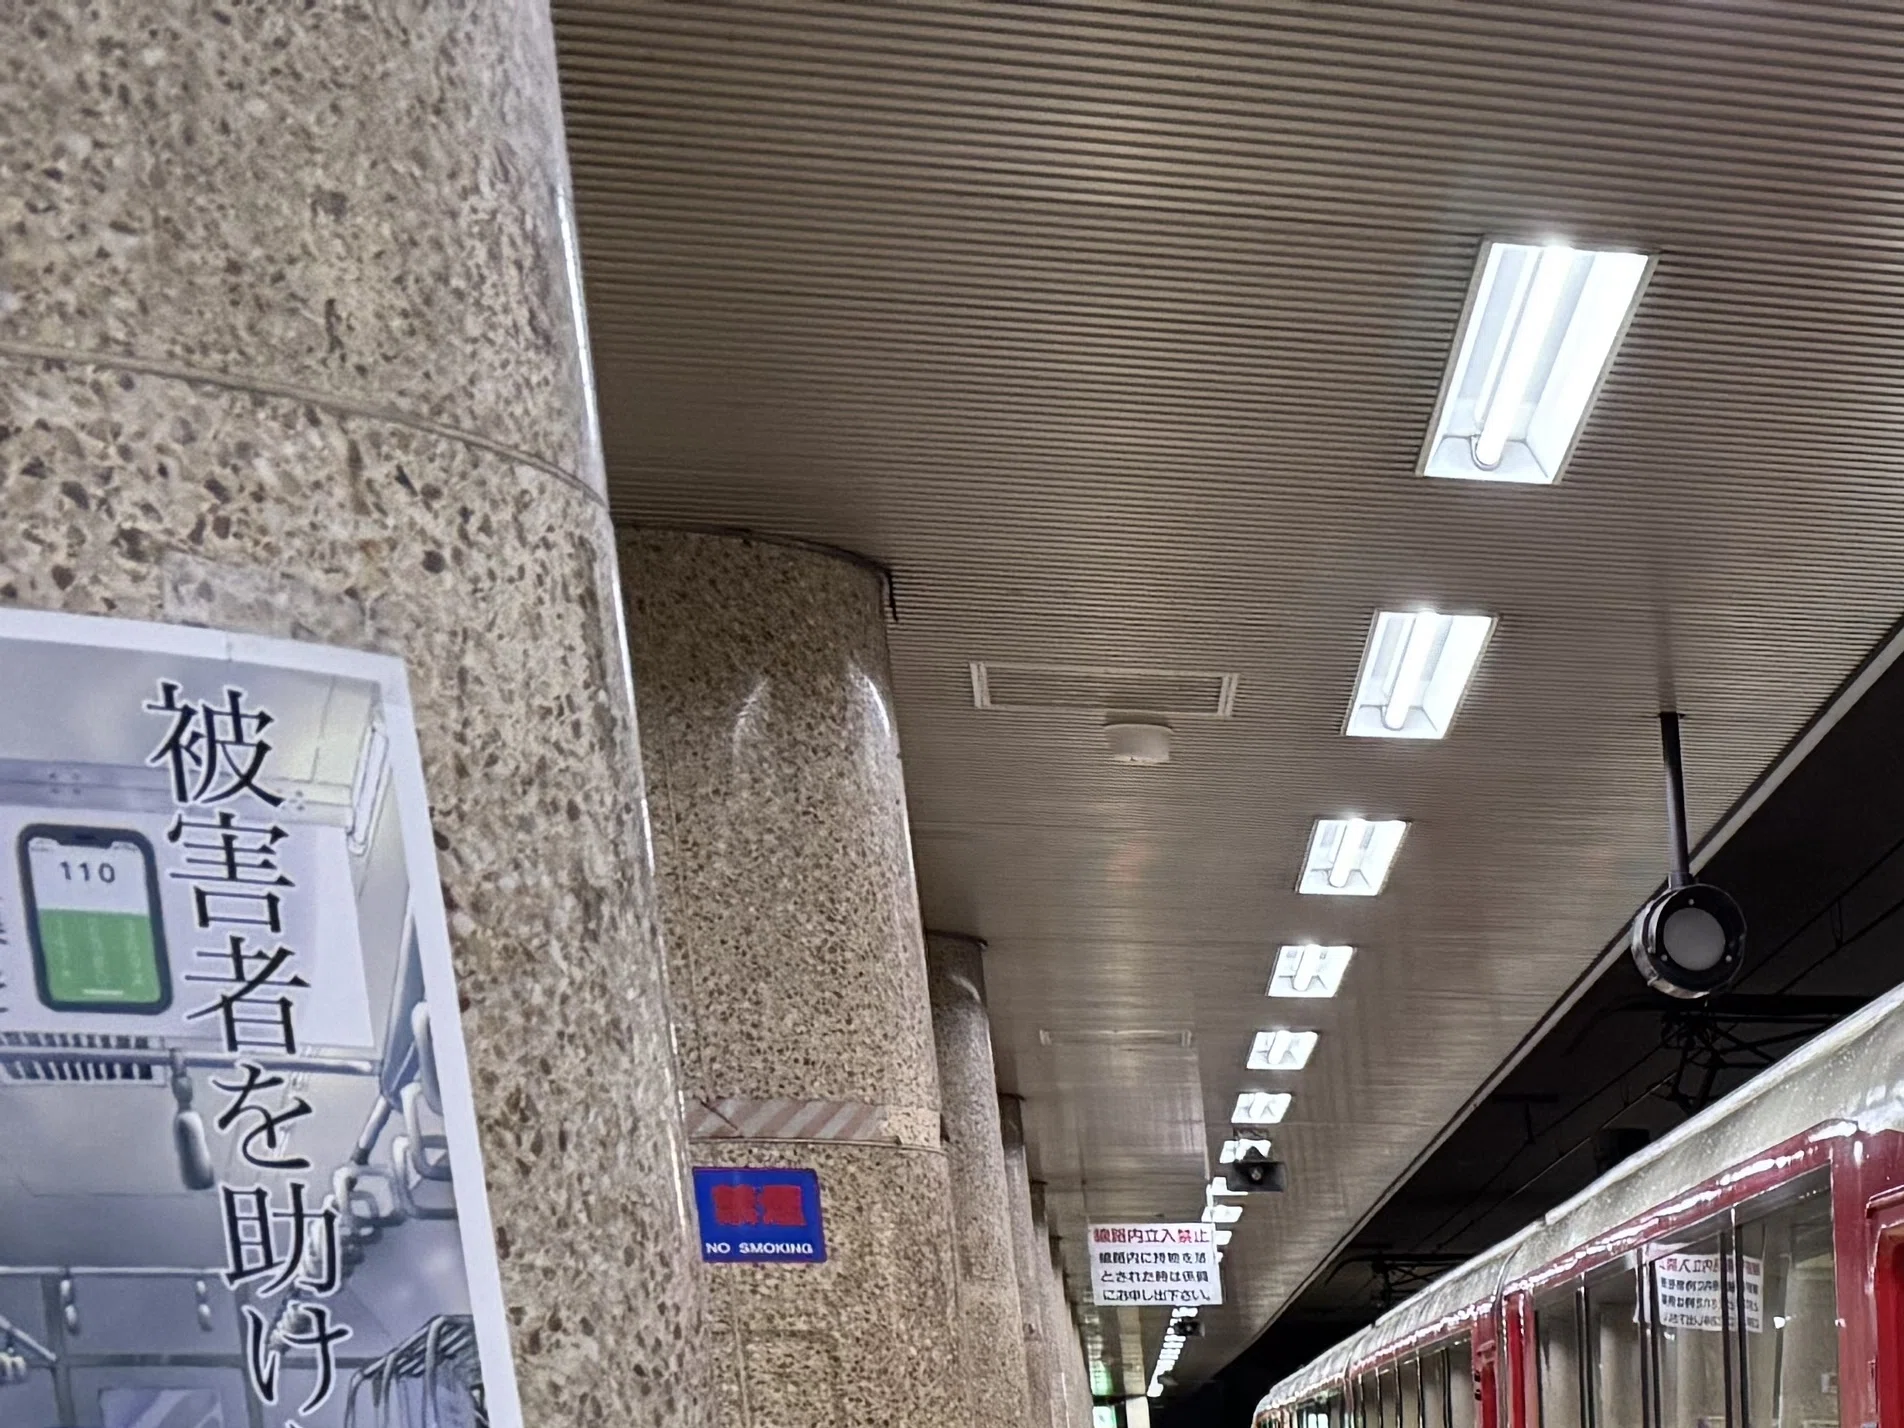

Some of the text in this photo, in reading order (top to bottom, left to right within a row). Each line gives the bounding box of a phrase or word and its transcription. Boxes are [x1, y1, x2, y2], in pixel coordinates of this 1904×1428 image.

[59, 860, 117, 885] 110
[705, 1242, 813, 1254] NO SMOKING
